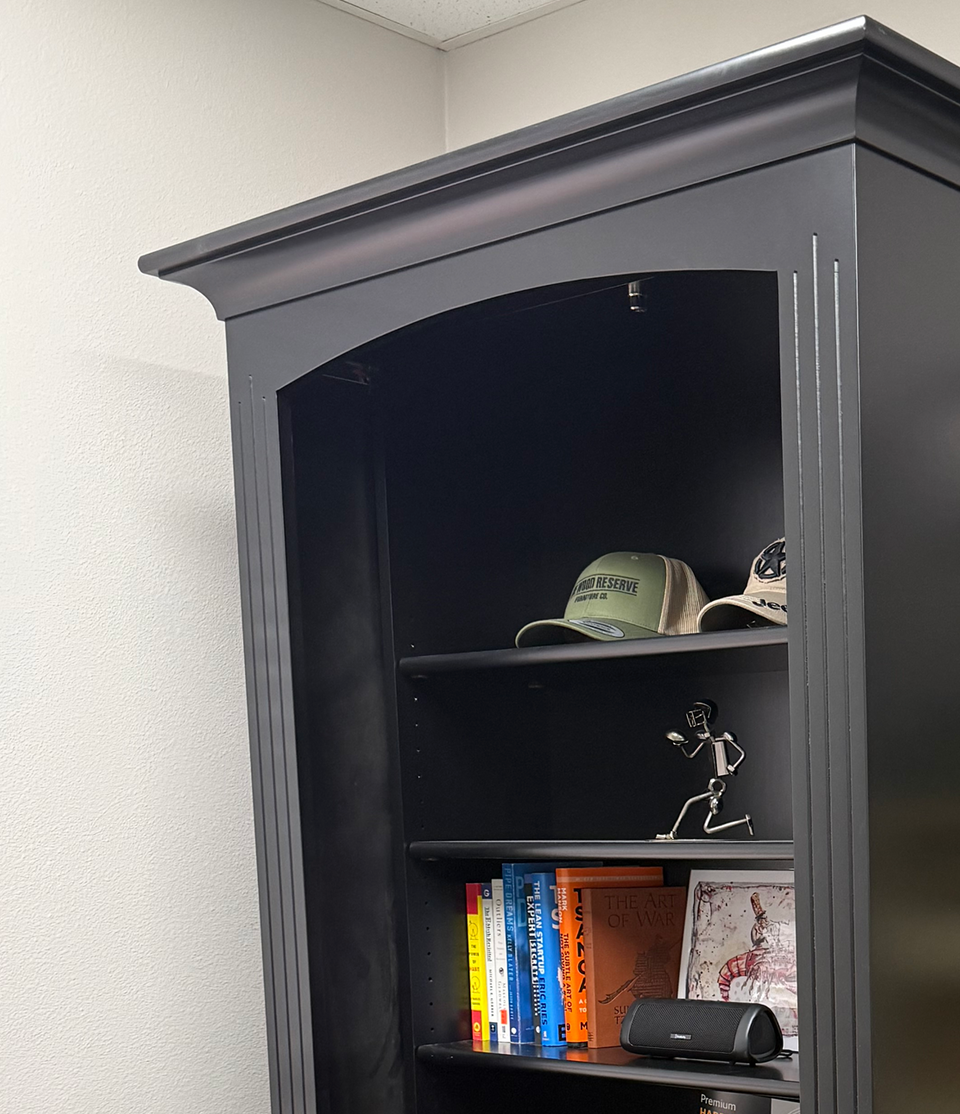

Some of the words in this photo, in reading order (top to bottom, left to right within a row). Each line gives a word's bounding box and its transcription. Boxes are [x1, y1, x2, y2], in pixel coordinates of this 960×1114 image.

[596, 576, 639, 594] RESERVE
[752, 598, 788, 613] Jee
[604, 895, 638, 910] THE
[644, 893, 677, 909] ART
[505, 892, 514, 932] DREAMS
[526, 896, 537, 938] EXPERT
[535, 903, 543, 930] LEAN
[608, 914, 629, 928] OF
[637, 911, 675, 927] WAR
[537, 931, 545, 975] STARTUP
[567, 1001, 573, 1013] OF
[614, 1005, 629, 1015] SU
[700, 1093, 736, 1111] Premium
